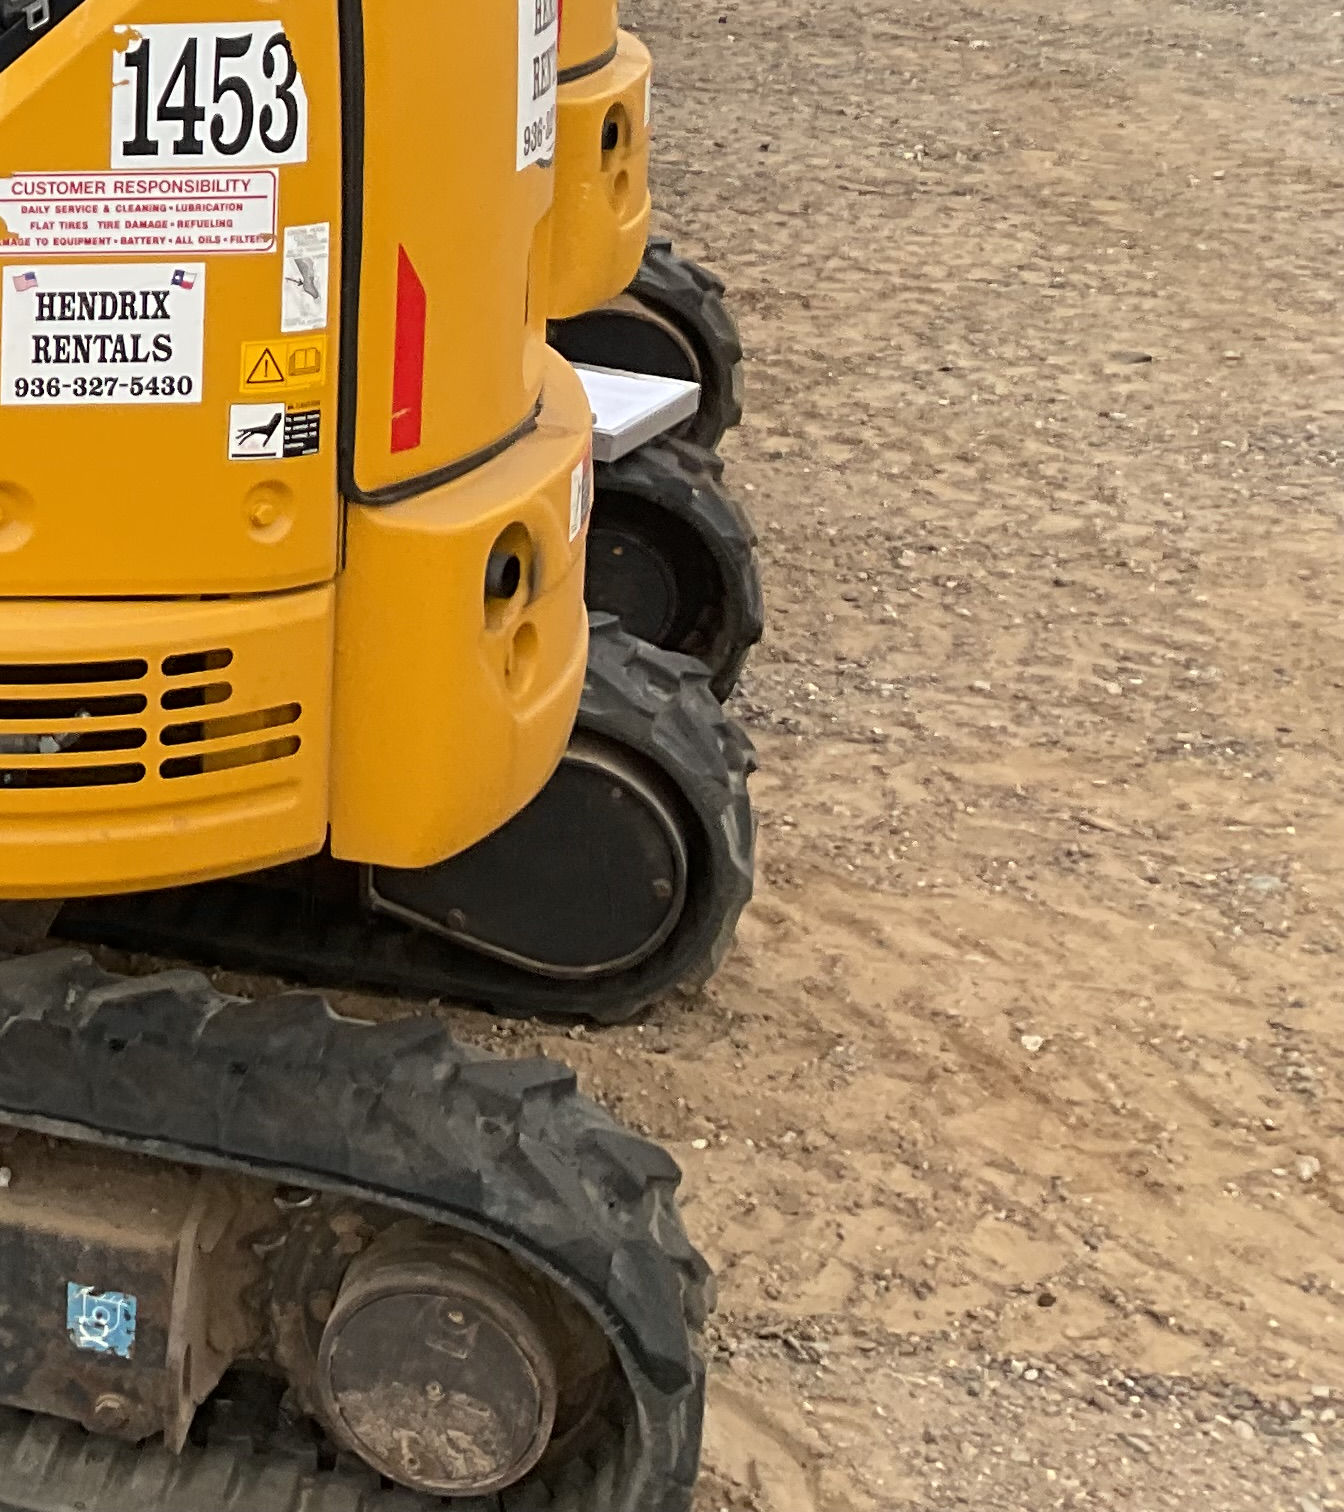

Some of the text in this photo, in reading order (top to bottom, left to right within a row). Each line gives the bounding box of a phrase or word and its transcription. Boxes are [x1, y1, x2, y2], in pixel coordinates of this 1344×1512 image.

[122, 31, 299, 156] 1453
[11, 178, 252, 196] CUSTOMER RESPONSIBILITY
[20, 202, 244, 215] DAILY SERVICE & CLEANING LUBRICATION
[30, 218, 234, 230] FLAT TIRES TIRE DAMAGE REFUELING
[36, 236, 49, 246] TO
[53, 236, 111, 246] EQUIPMENT
[120, 235, 165, 245] BATTERY
[175, 234, 194, 245] ALL
[198, 234, 221, 245] OILS
[34, 289, 171, 322] HENDRIX
[31, 333, 173, 364] RENTALS
[14, 375, 193, 398] 936-327-5430
